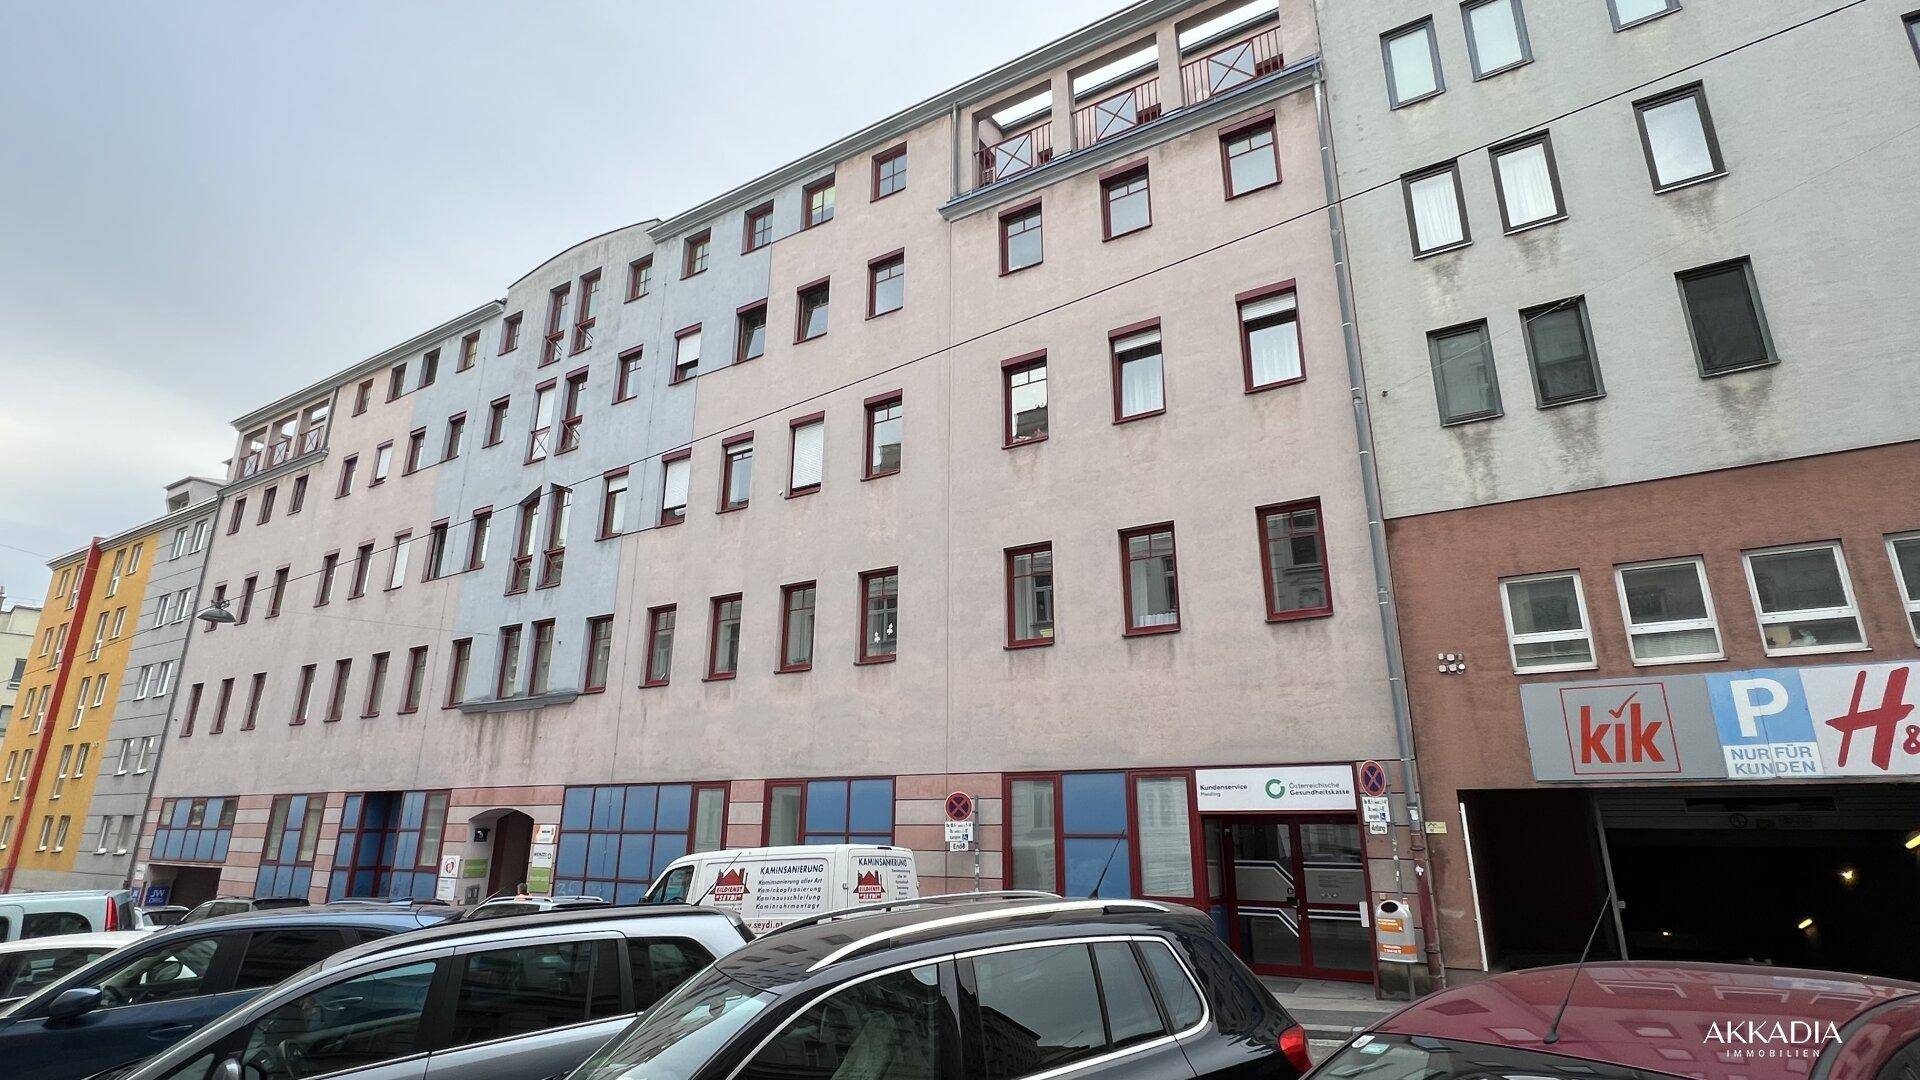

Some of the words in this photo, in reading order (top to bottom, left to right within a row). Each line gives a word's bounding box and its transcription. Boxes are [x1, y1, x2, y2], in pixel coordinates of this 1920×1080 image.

[1729, 677, 1789, 738] P
[1730, 745, 1769, 761] NUR
[1774, 743, 1813, 759] FÜR
[1734, 761, 1817, 775] KUNDEN
[1199, 783, 1248, 791] Kundenservice
[1288, 781, 1341, 790] Österreichische
[757, 886, 823, 894] Kaminkopfsanierung
[756, 894, 822, 902] Kaminausschleifung
[755, 902, 821, 910] Kaminrohrmontage
